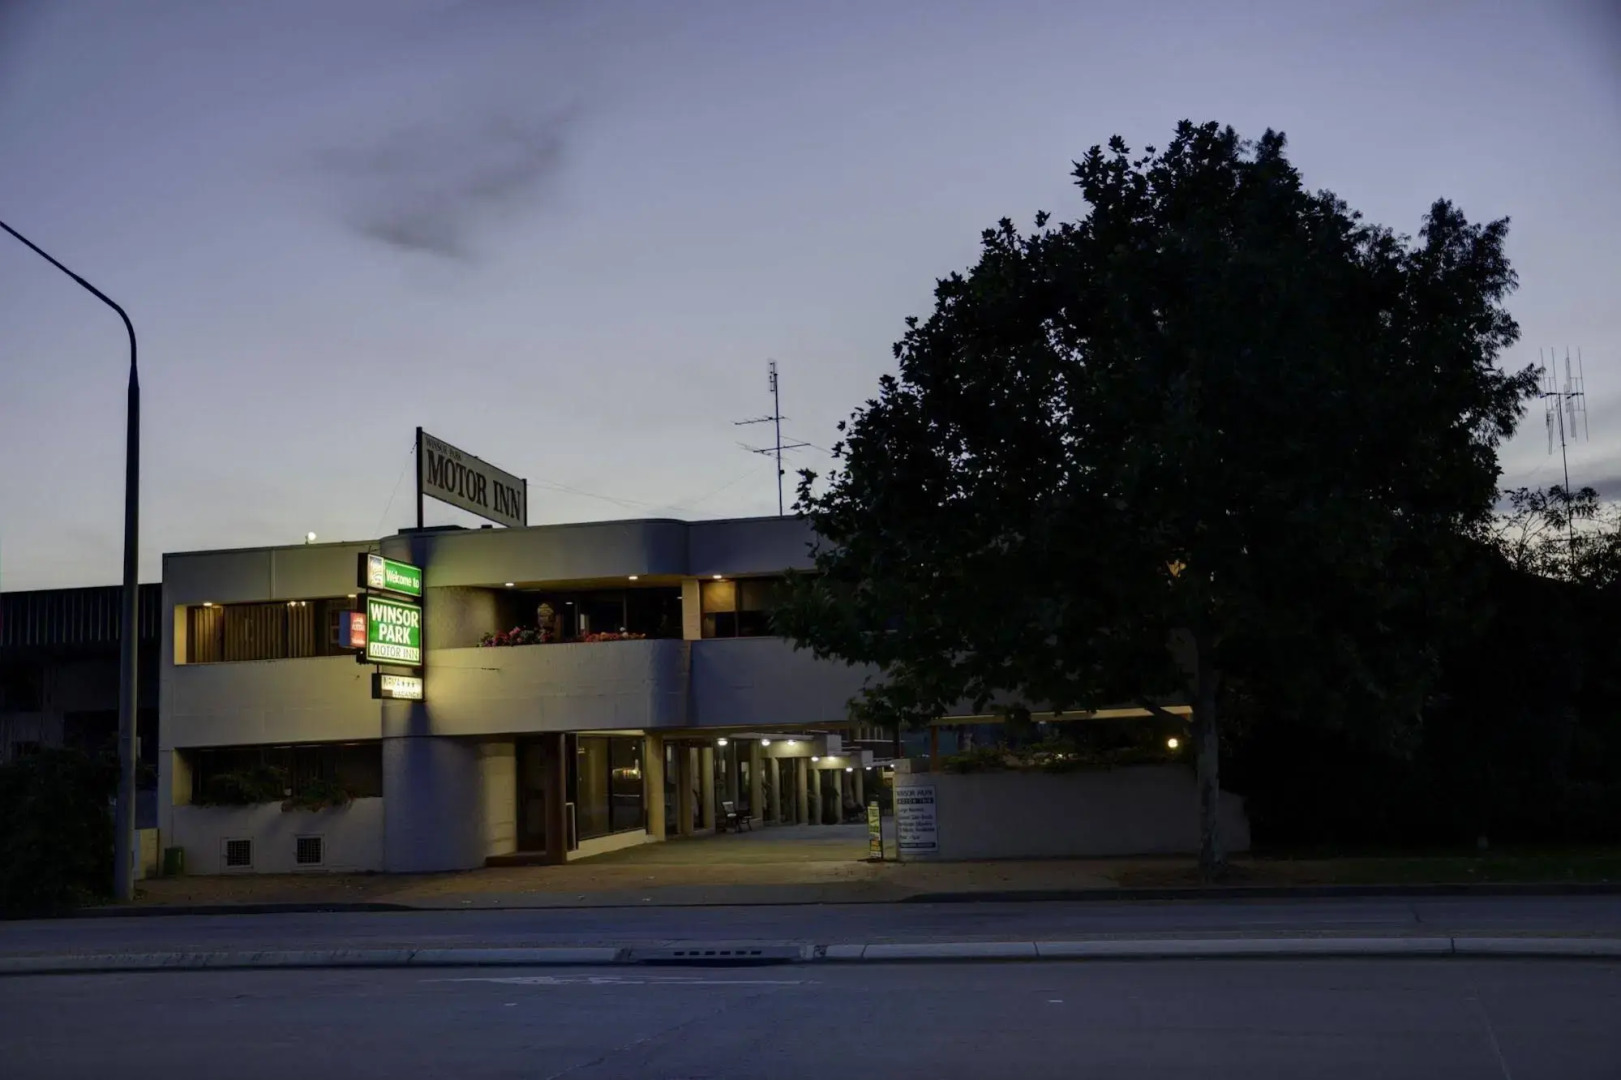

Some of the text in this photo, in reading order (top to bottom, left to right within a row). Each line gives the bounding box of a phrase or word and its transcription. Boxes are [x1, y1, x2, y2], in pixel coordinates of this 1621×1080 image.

[427, 449, 521, 521] MOTOR INN
[386, 569, 420, 589] Welcome to
[370, 602, 419, 628] WINSOR
[378, 623, 411, 645] PARK
[371, 643, 419, 660] MOTOR INN
